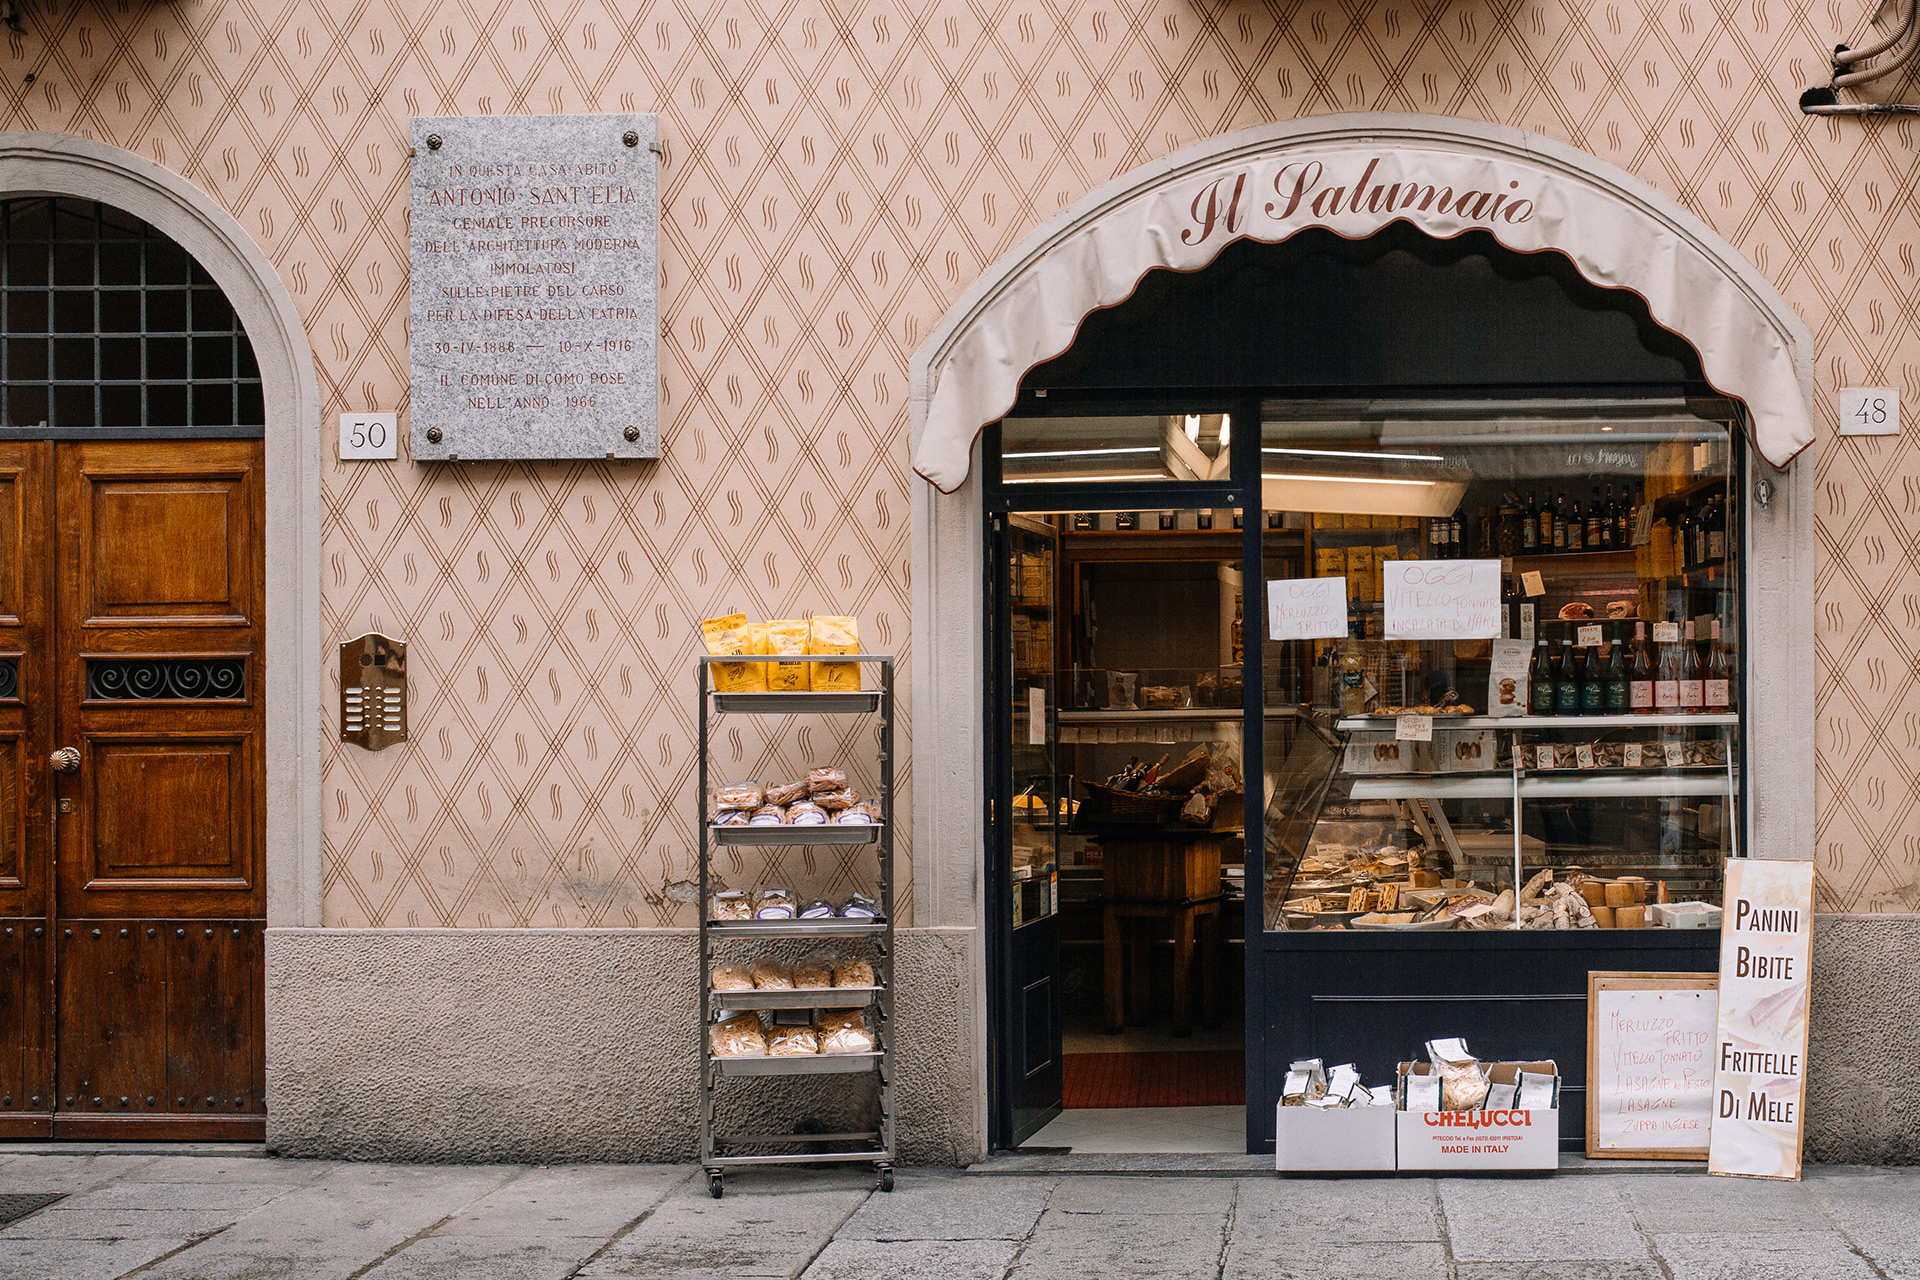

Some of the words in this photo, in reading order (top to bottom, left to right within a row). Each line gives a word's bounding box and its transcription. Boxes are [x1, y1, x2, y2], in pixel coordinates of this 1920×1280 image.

[449, 165, 463, 178] IN
[469, 164, 522, 178] QUESTA
[529, 163, 568, 177] CASA
[429, 187, 516, 207] ANTONIO
[529, 186, 637, 205] SANT'ELIA
[1180, 172, 1247, 247] Il
[1264, 157, 1534, 225] Salumaio
[453, 217, 513, 230] GENIALE
[521, 215, 613, 229] PRECURSORE
[425, 239, 568, 253] DELL'ARCHITETTURA
[574, 238, 641, 251] MODERNA
[490, 262, 576, 275] IMMOLATOSI
[442, 285, 484, 299] SULLE
[490, 285, 541, 299] PIETRE
[547, 284, 576, 297] DEL
[582, 284, 625, 297] CARSO
[426, 309, 454, 322] PER
[459, 309, 479, 322] LA
[483, 308, 534, 321] DIFESA
[539, 308, 585, 321] DELLA
[591, 307, 639, 320] PATRIA
[434, 341, 516, 355] 30-IV-1888
[558, 340, 632, 353] 10-X-1916
[439, 374, 453, 387] IL
[460, 374, 517, 387] COMUNE
[525, 373, 540, 386] DI
[544, 373, 584, 386] COMO
[590, 372, 626, 385] POSE
[468, 397, 550, 411] NELL'ANNO
[565, 396, 597, 409] 1966
[1855, 397, 1887, 425] 48
[350, 422, 386, 448] 50
[1403, 565, 1474, 585] OGGI
[1289, 583, 1330, 599] OGGI
[1390, 586, 1451, 612] VITELLO
[1275, 603, 1329, 629] MERLUZZO
[1392, 619, 1447, 632] INSALATA
[1467, 613, 1499, 631] MARE
[1297, 617, 1338, 637] FRITTO
[1610, 1009, 1675, 1038] MERLUZZO
[1663, 1030, 1709, 1046] FRITTO
[1612, 1040, 1655, 1072] VITELLO
[1655, 1049, 1703, 1073] TONNATO
[1614, 1074, 1671, 1095] LASAGNE
[1683, 1067, 1711, 1093] PESTO
[1617, 1097, 1677, 1116] LASAGNE
[1423, 1109, 1532, 1130] CHELUCCI
[1622, 1119, 1658, 1134] ZUPPA
[1662, 1118, 1700, 1131] INGLESE
[1441, 1145, 1469, 1153] MADE
[1471, 1145, 1481, 1153] IN
[1483, 1145, 1509, 1153] ITALY
